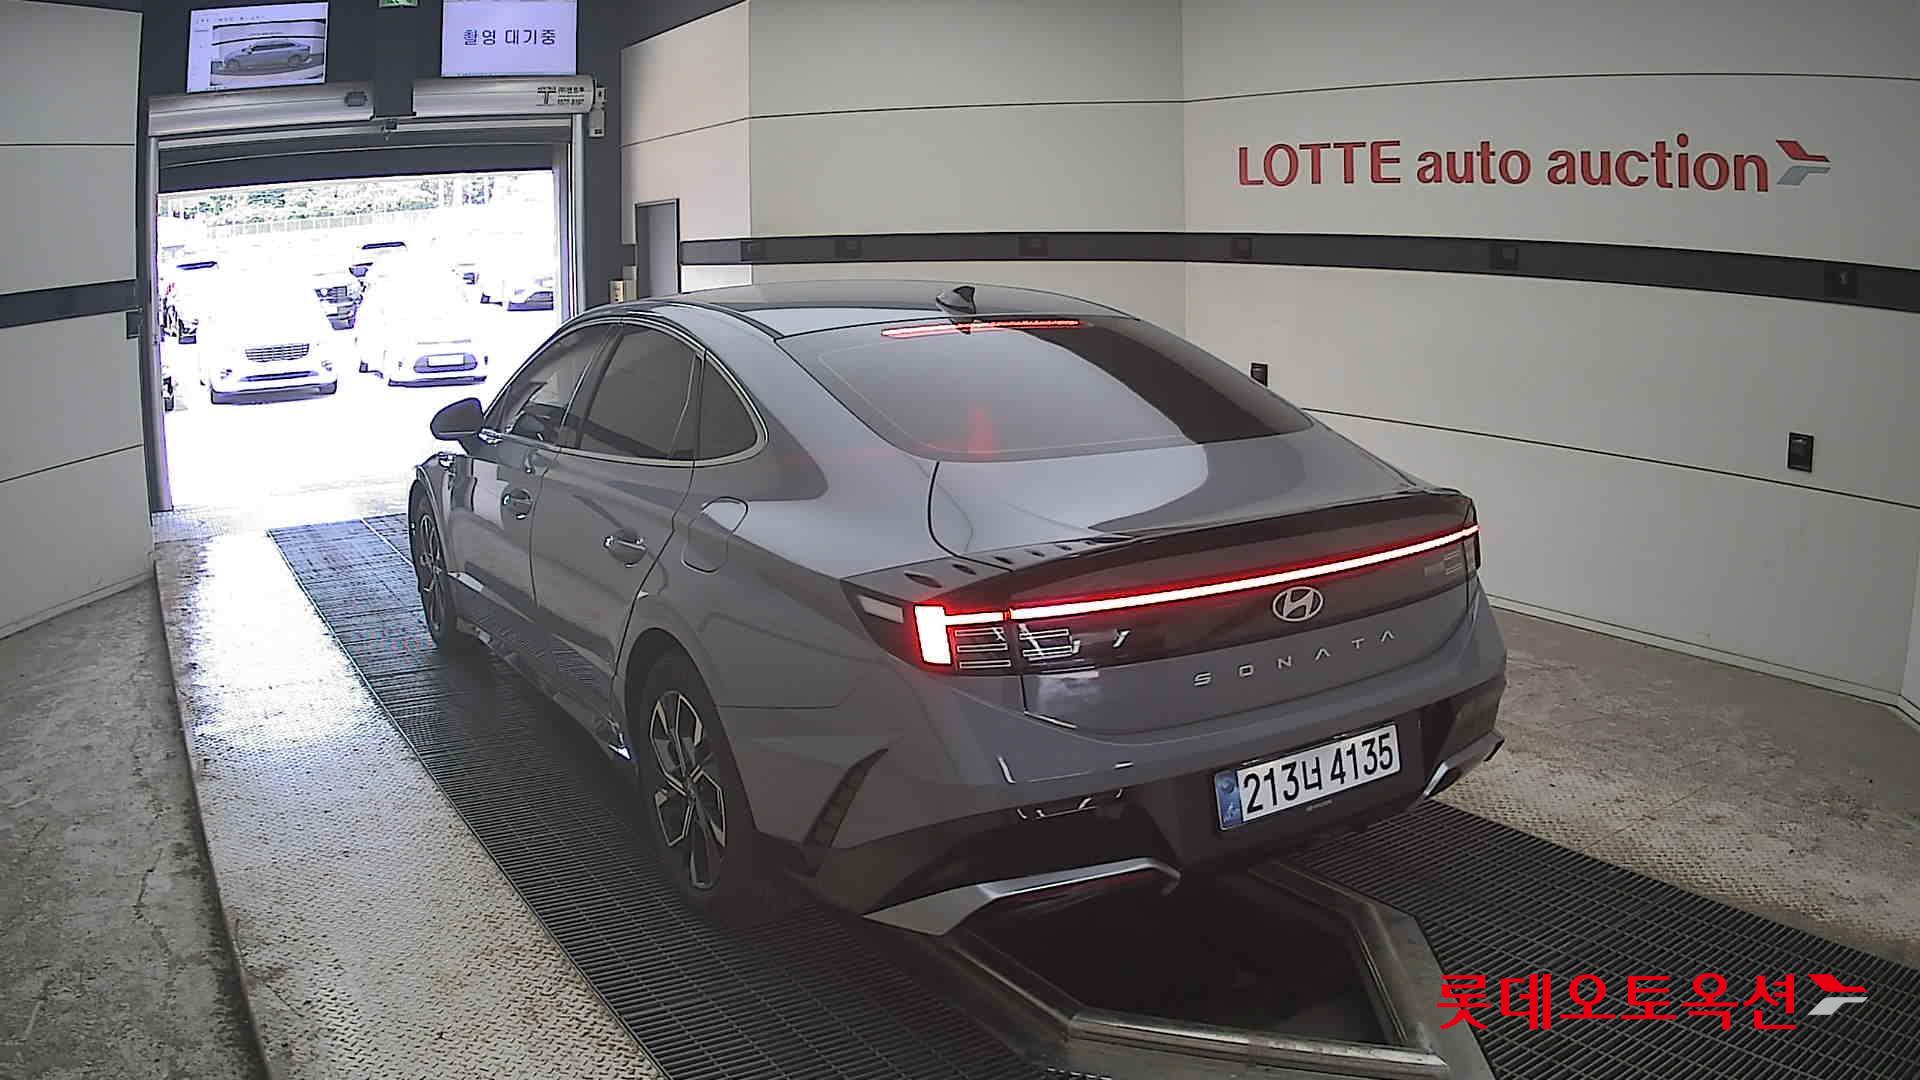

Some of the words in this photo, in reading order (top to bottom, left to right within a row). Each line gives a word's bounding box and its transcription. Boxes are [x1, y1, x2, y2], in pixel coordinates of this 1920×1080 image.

[504, 29, 556, 46] 대기중
[1238, 140, 1400, 186] LOTTE
[1416, 140, 1532, 185] auto
[1546, 132, 1769, 193] auction
[1193, 630, 1395, 687] SONATA
[1243, 757, 1322, 814] 213너
[1330, 732, 1394, 786] 4135
